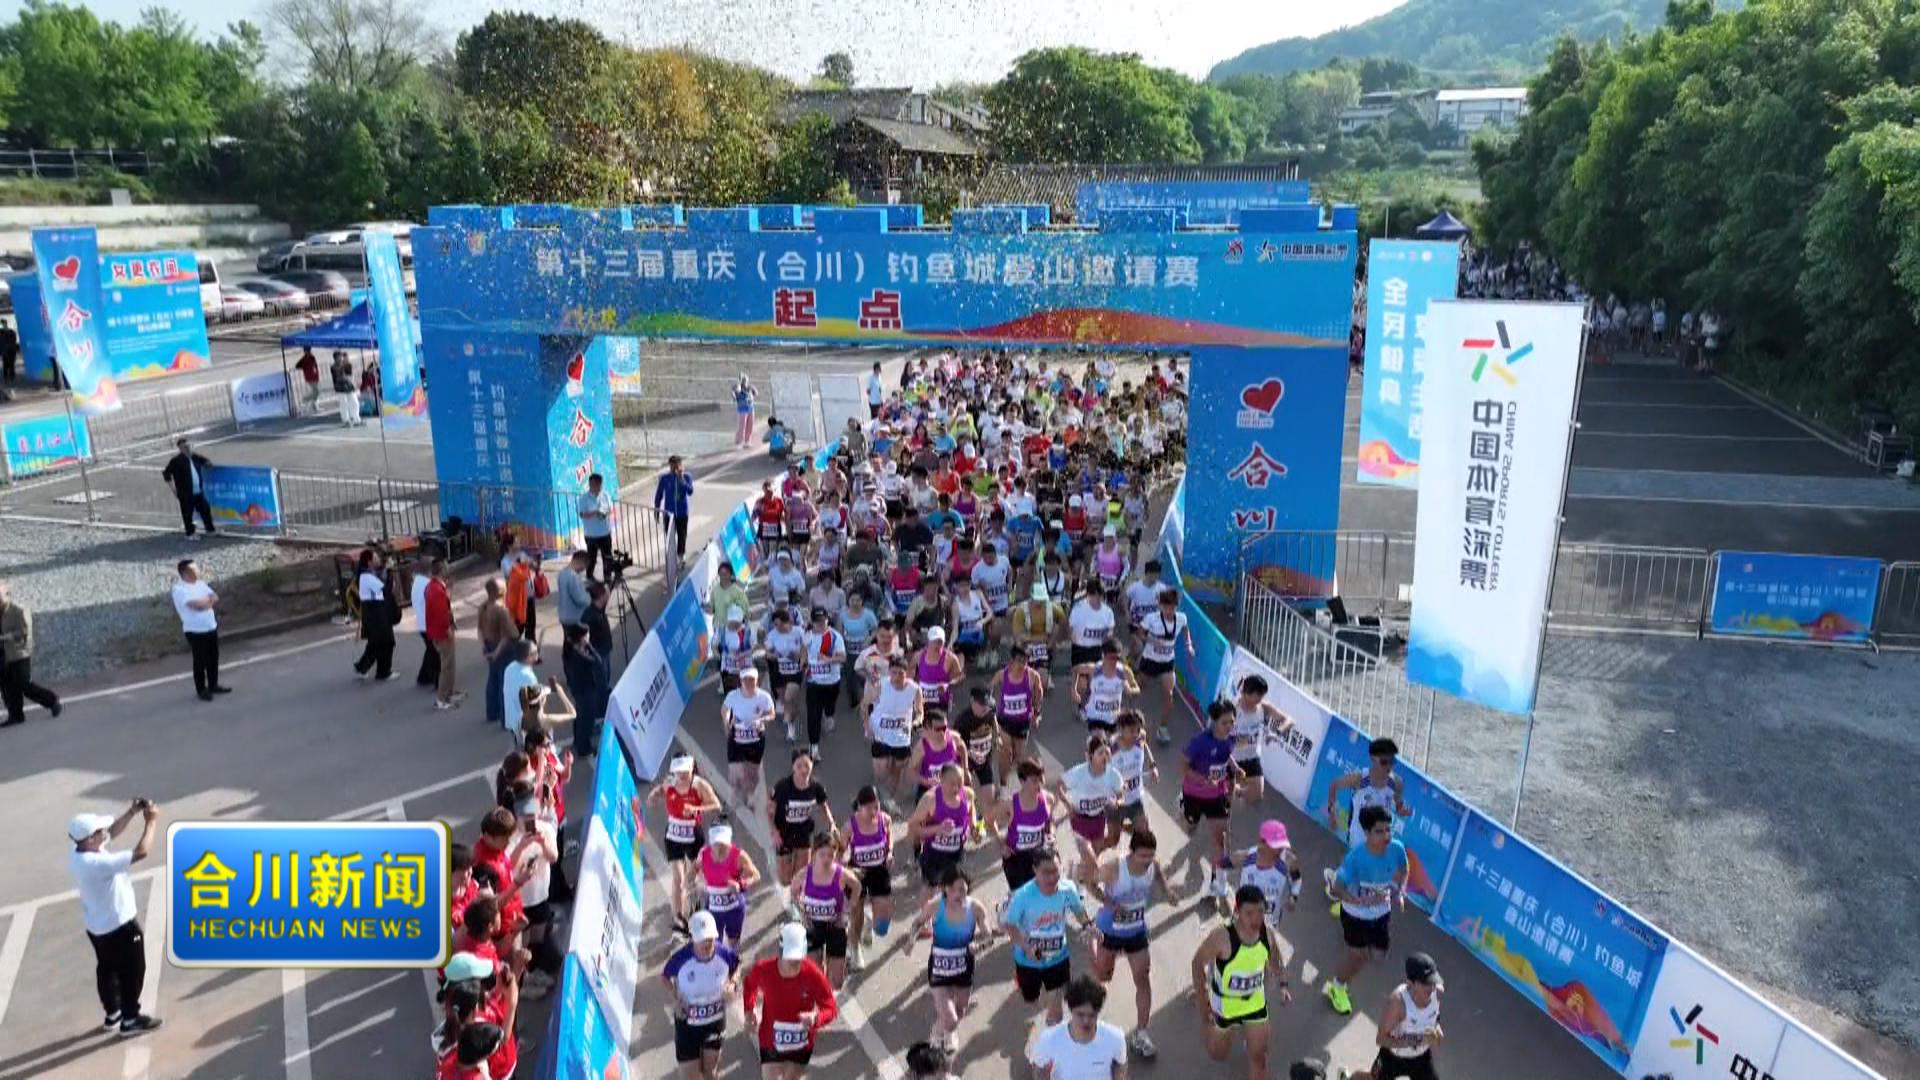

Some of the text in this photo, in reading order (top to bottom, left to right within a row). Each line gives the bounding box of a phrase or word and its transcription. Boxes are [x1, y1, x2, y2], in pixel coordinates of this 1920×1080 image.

[773, 288, 903, 331] 起点
[1227, 441, 1288, 544] 合川
[1730, 1053, 1776, 1080] 中
